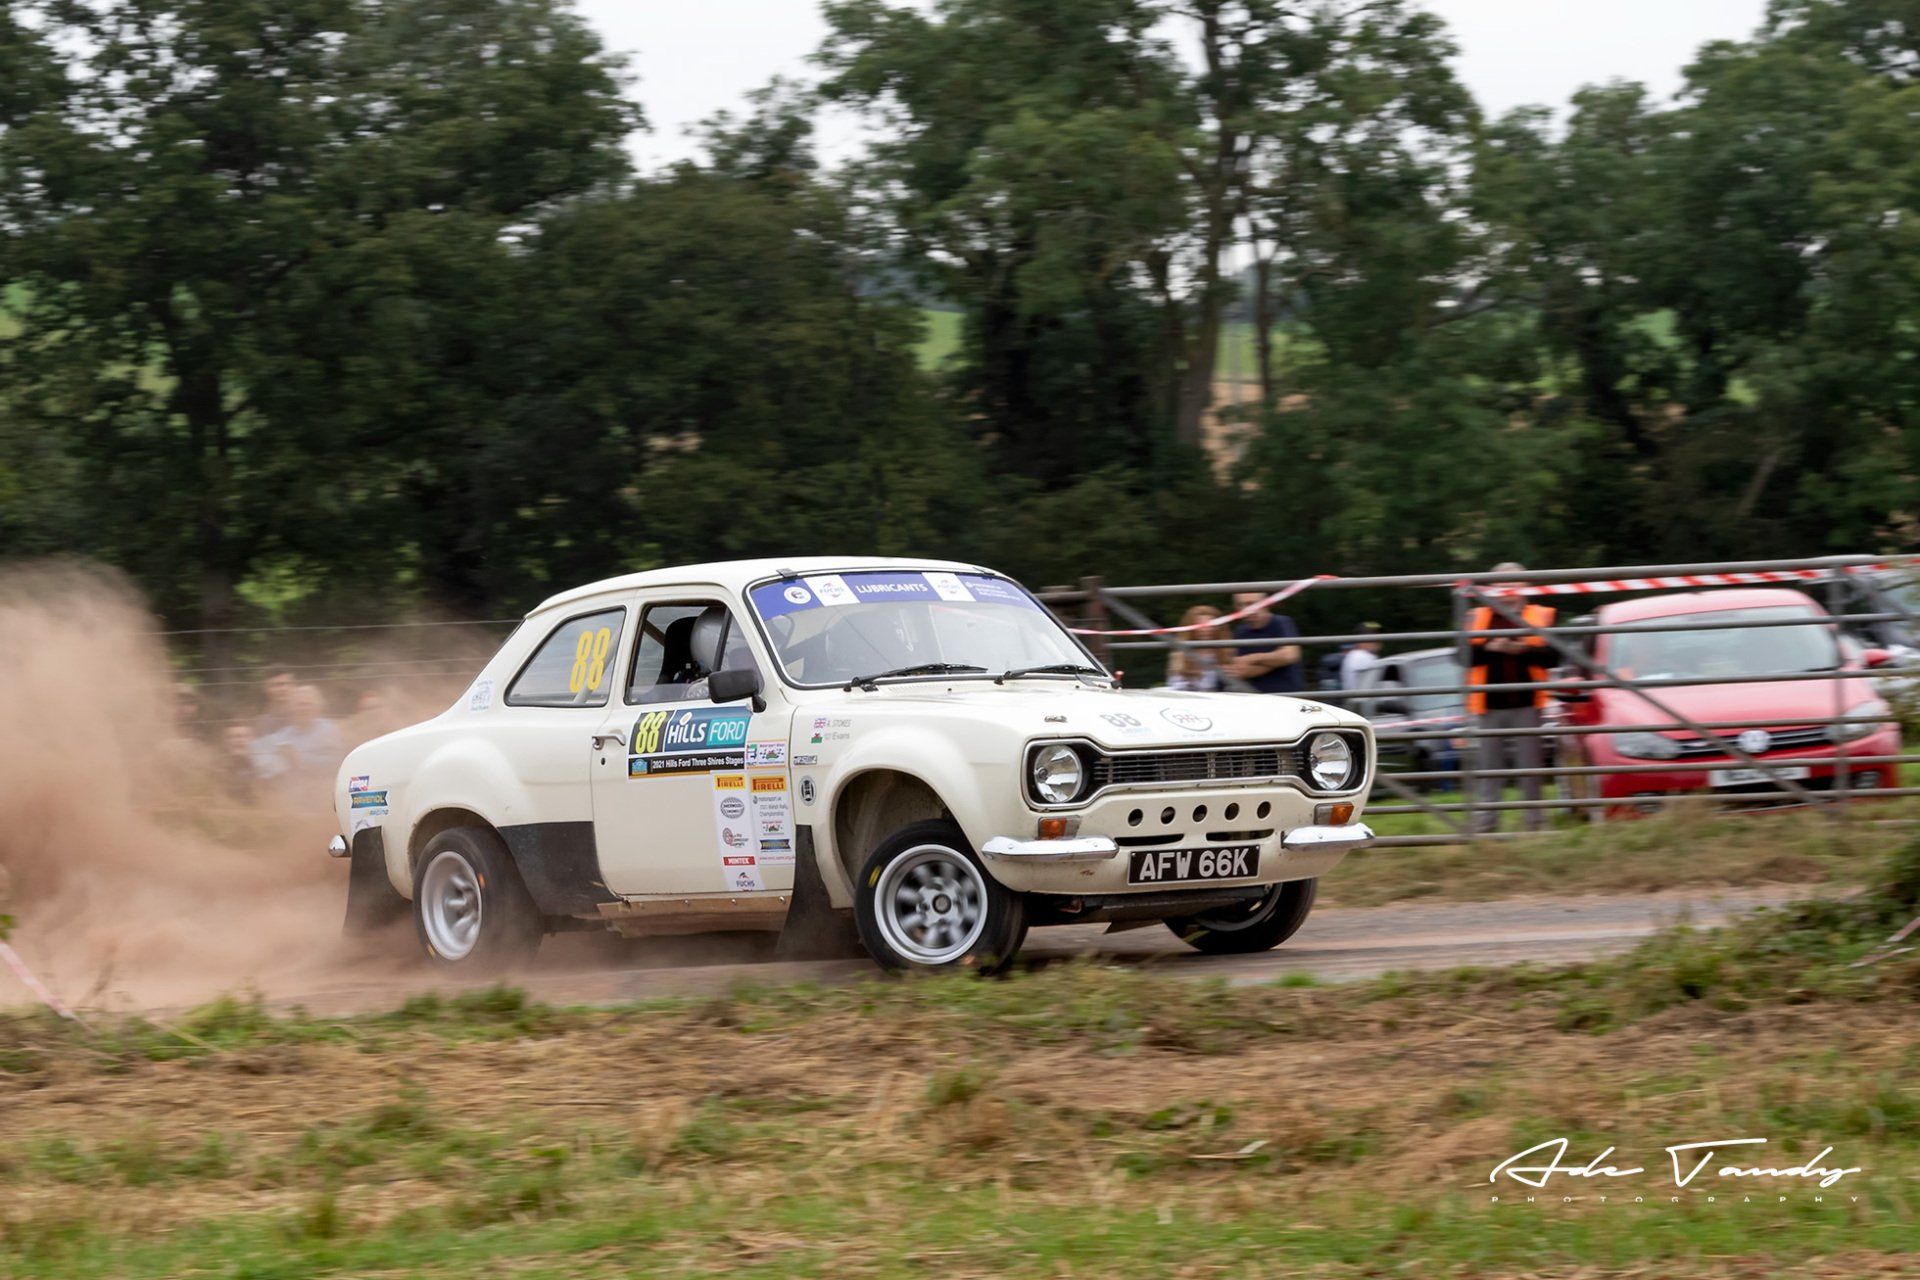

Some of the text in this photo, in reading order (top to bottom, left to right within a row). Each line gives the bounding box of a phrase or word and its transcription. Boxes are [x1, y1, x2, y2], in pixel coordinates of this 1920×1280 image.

[855, 583, 929, 594] LUBRICANTS
[569, 627, 611, 693] 88
[635, 711, 668, 754] 88
[709, 720, 746, 742] FORD
[652, 759, 665, 769] 2021
[666, 759, 678, 768] Hills
[678, 757, 691, 767] Ford
[692, 757, 707, 766] Three
[707, 755, 725, 766] Shires
[725, 754, 744, 767] Stages
[717, 776, 744, 788] PIRELLI
[752, 777, 785, 791] PIRELLI
[1139, 848, 1250, 881] AFW 66K
[736, 880, 755, 888] FUCHS
